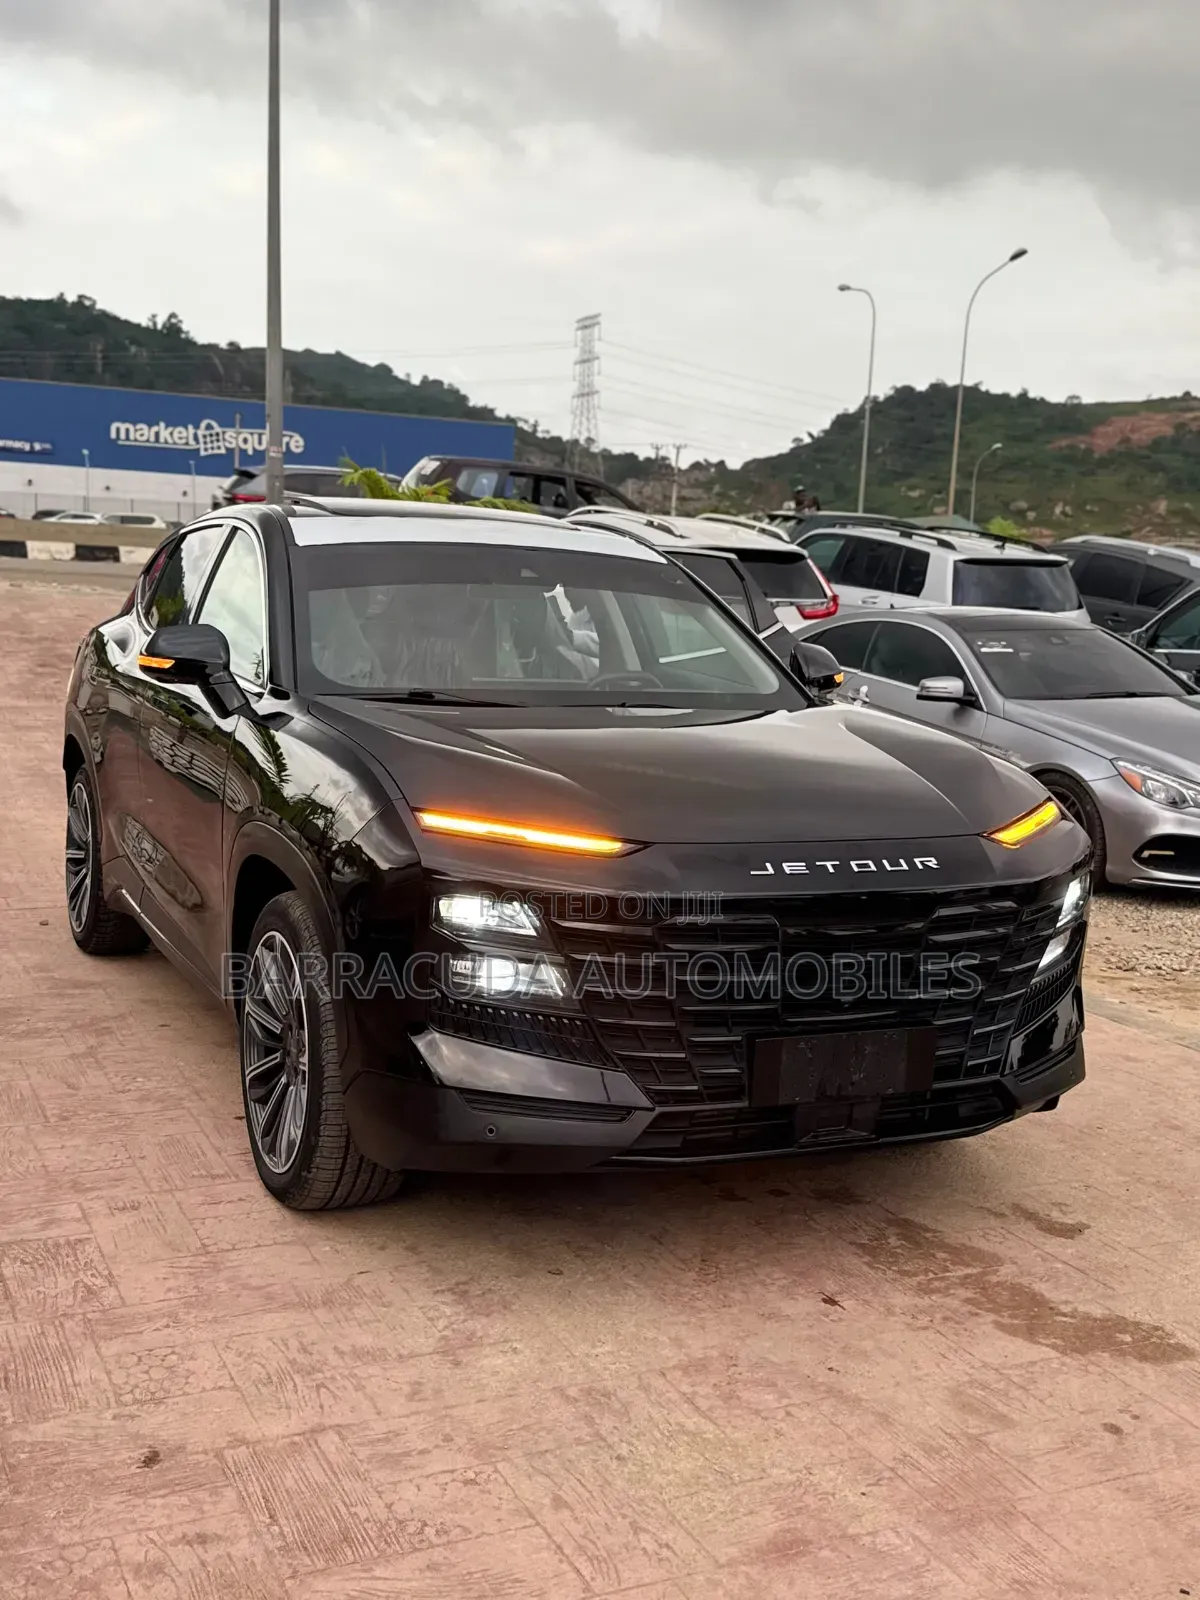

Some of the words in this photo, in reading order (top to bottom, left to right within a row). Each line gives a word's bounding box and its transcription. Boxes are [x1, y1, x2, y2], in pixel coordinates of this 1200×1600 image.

[110, 421, 196, 446] market
[224, 428, 305, 456] squre
[750, 856, 941, 876] JETOUR
